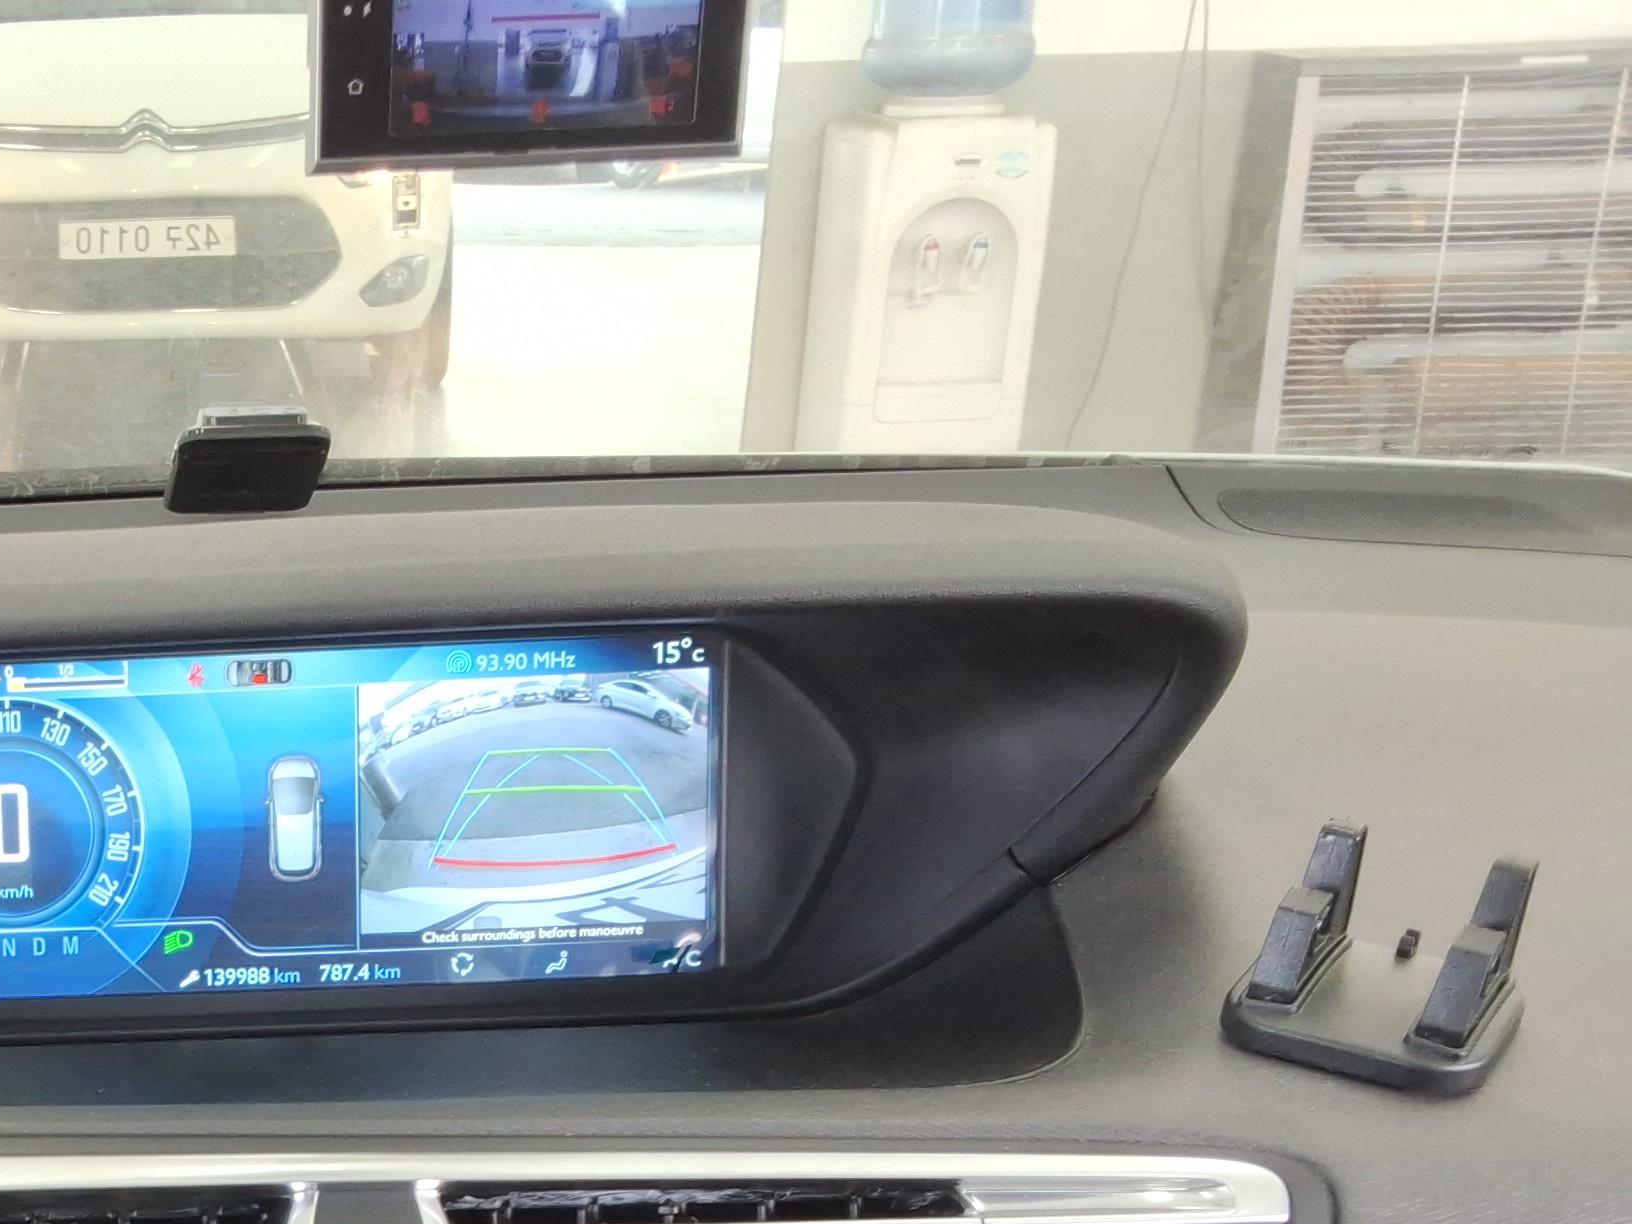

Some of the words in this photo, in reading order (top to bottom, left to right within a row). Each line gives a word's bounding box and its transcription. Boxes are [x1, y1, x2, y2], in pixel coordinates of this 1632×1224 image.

[476, 653, 527, 672] 93.90
[533, 651, 576, 671] MHz
[41, 717, 71, 747] 130
[78, 741, 108, 777] 150
[101, 784, 128, 817] 170
[106, 831, 131, 862] 190
[88, 872, 119, 907] 210
[422, 931, 459, 943] Check
[461, 928, 536, 942] surroundings
[538, 926, 577, 939] before
[579, 925, 644, 937] manoeuvre
[3, 940, 16, 956] N
[33, 939, 46, 956] D
[63, 938, 79, 955] M
[204, 967, 269, 986] 139988
[274, 966, 301, 984] km
[319, 963, 369, 982] 787.4
[374, 962, 401, 981] km
